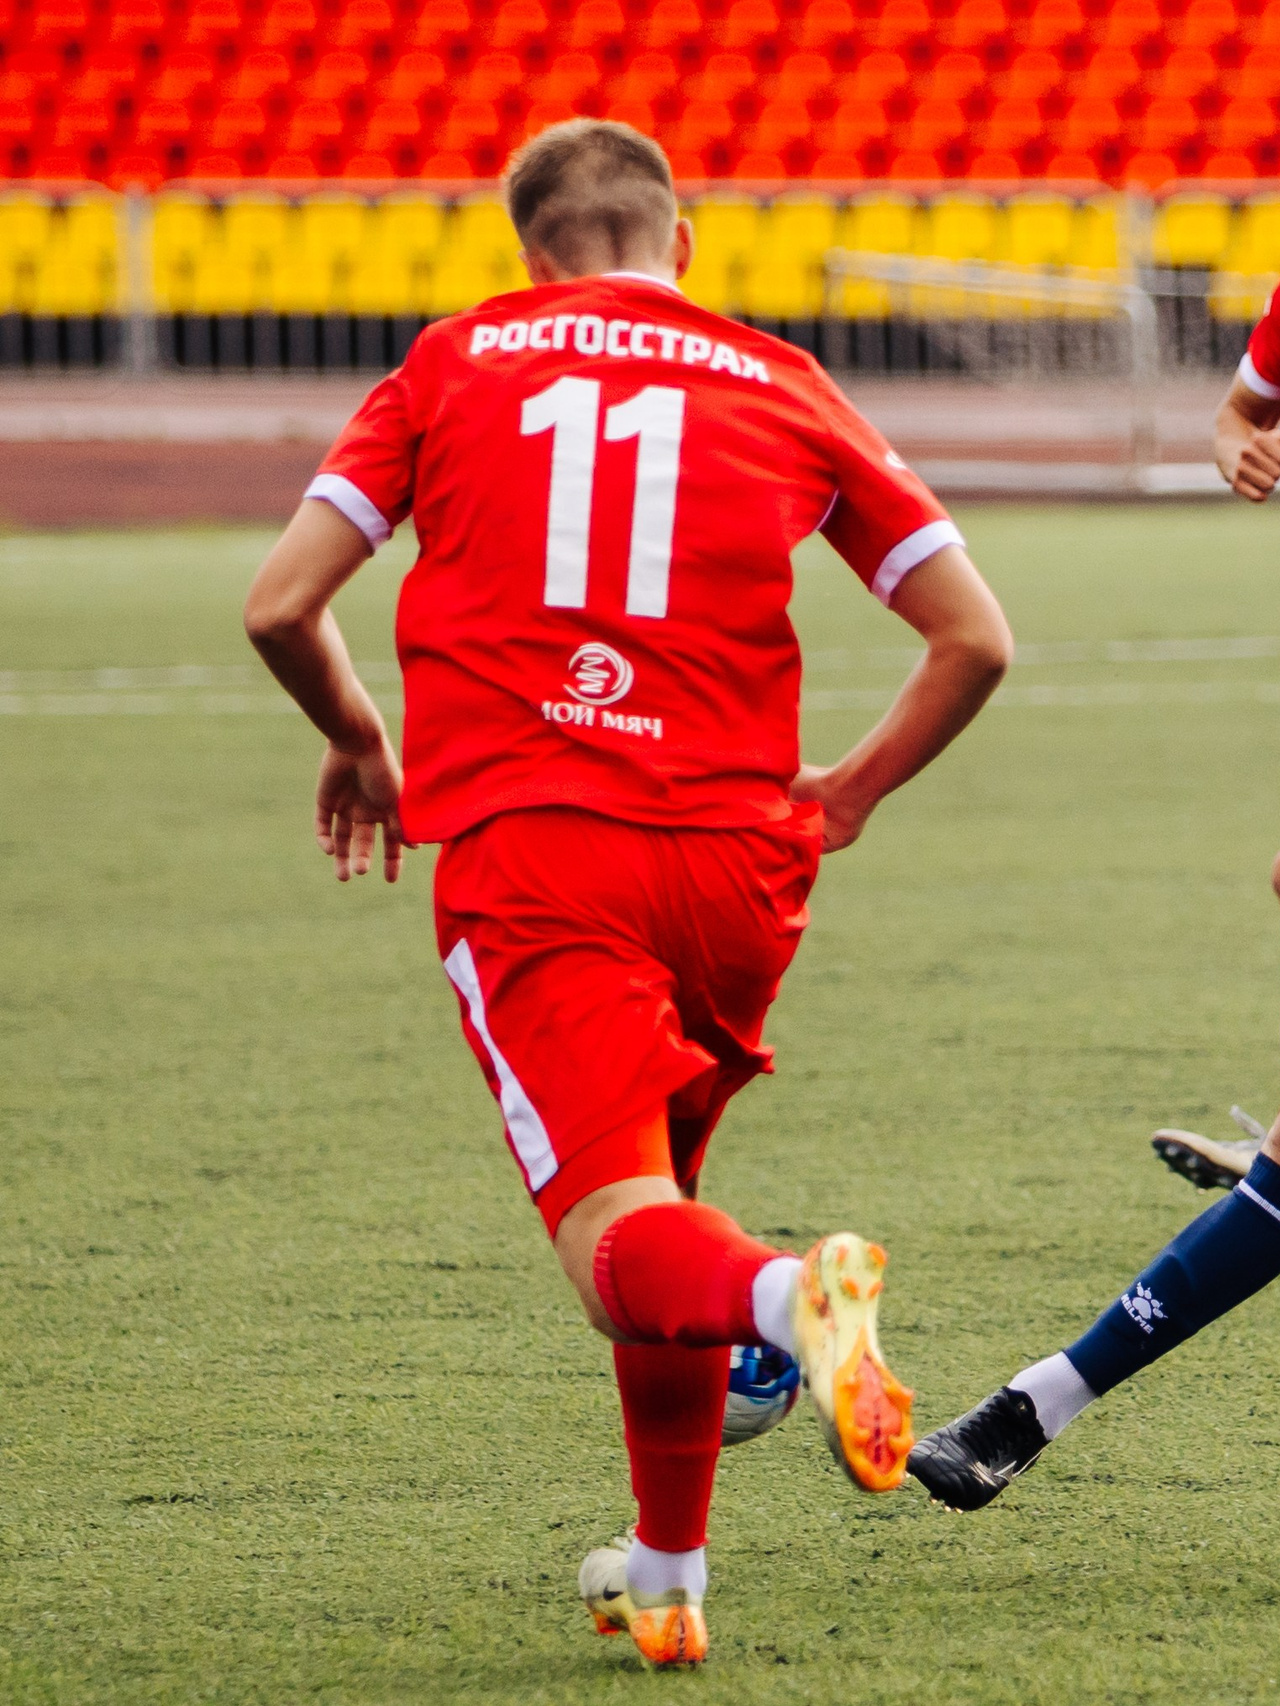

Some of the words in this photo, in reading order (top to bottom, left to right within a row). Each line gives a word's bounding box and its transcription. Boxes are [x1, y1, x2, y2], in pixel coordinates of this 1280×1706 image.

[470, 314, 772, 384] РОСГОССТРАХ
[519, 375, 686, 619] 11
[1121, 1293, 1154, 1334] KELME
